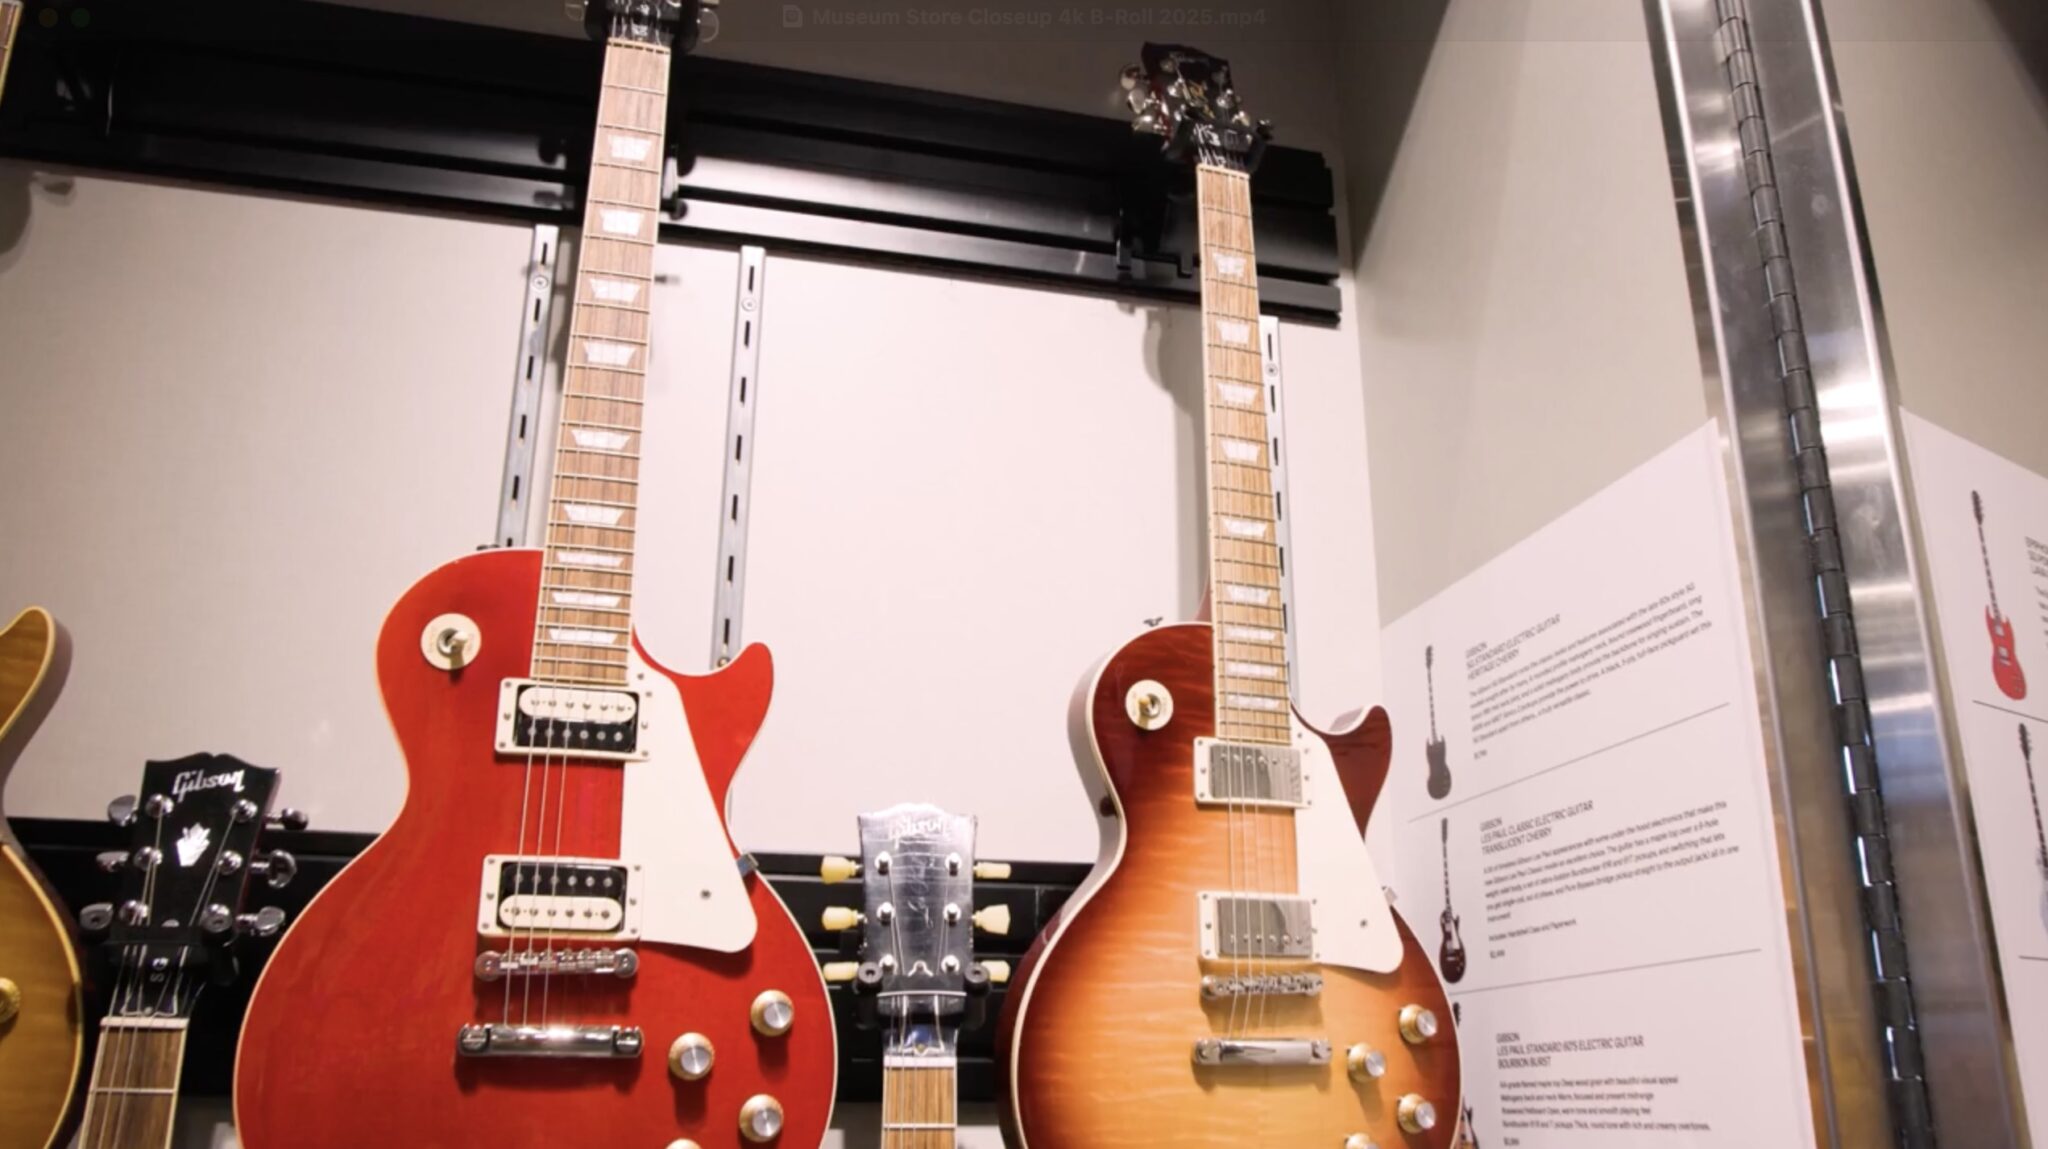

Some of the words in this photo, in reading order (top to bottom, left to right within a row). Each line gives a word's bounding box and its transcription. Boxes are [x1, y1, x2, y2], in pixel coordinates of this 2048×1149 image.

[1537, 614, 1559, 633] GUITAR
[172, 769, 245, 803] Gibson
[1567, 800, 1592, 816] GUITAR
[1578, 1038, 1612, 1050] ELECTRIC
[1614, 1035, 1643, 1048] GUITAR
[1529, 1055, 1550, 1067] BURST
